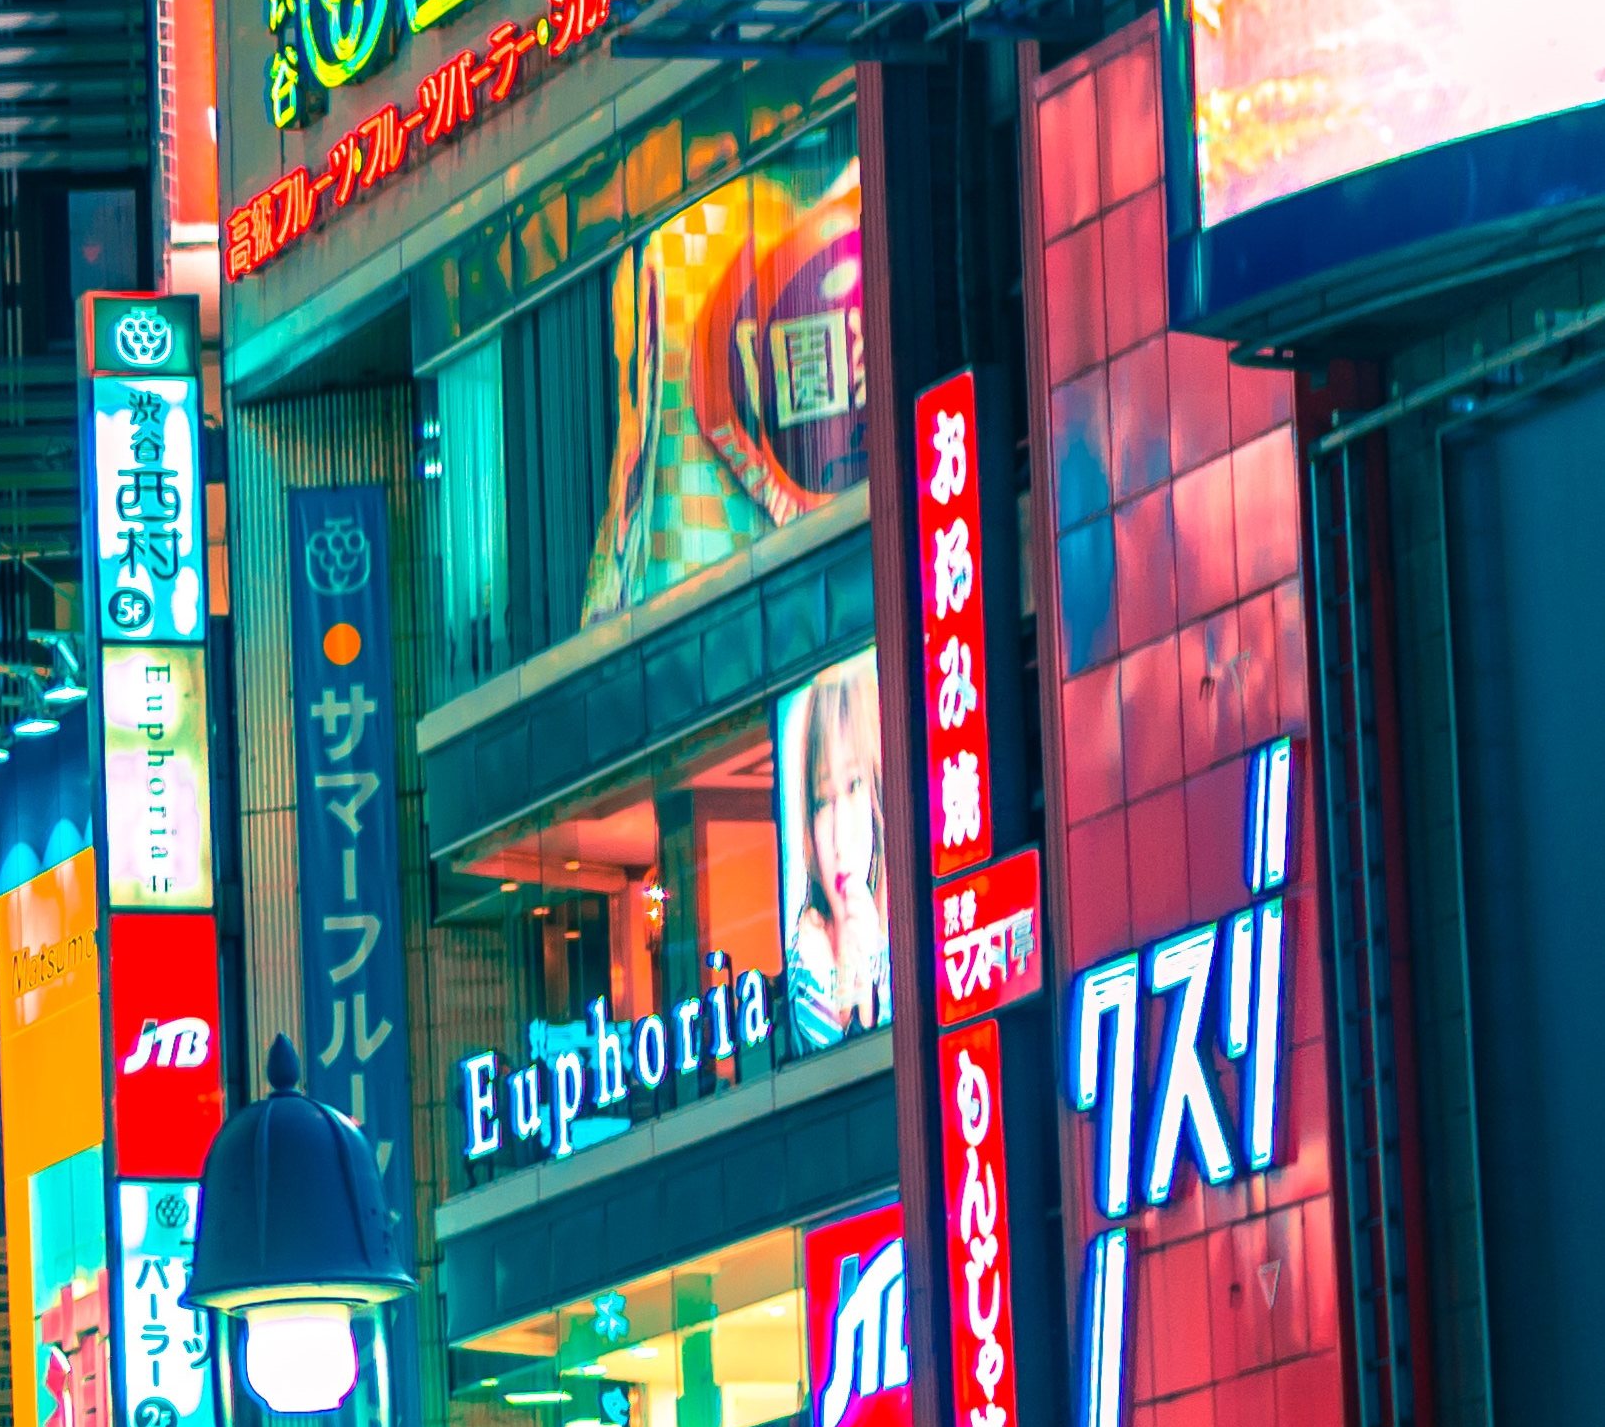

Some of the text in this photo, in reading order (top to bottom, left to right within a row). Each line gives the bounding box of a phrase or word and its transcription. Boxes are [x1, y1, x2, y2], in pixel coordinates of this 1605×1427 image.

[114, 595, 145, 622] 5F
[144, 661, 173, 862] Euphoria
[122, 1017, 212, 1075] JTB
[460, 950, 771, 1161] Euphoria
[1071, 894, 1286, 1221] クスリ
[135, 1257, 172, 1387] パーラー
